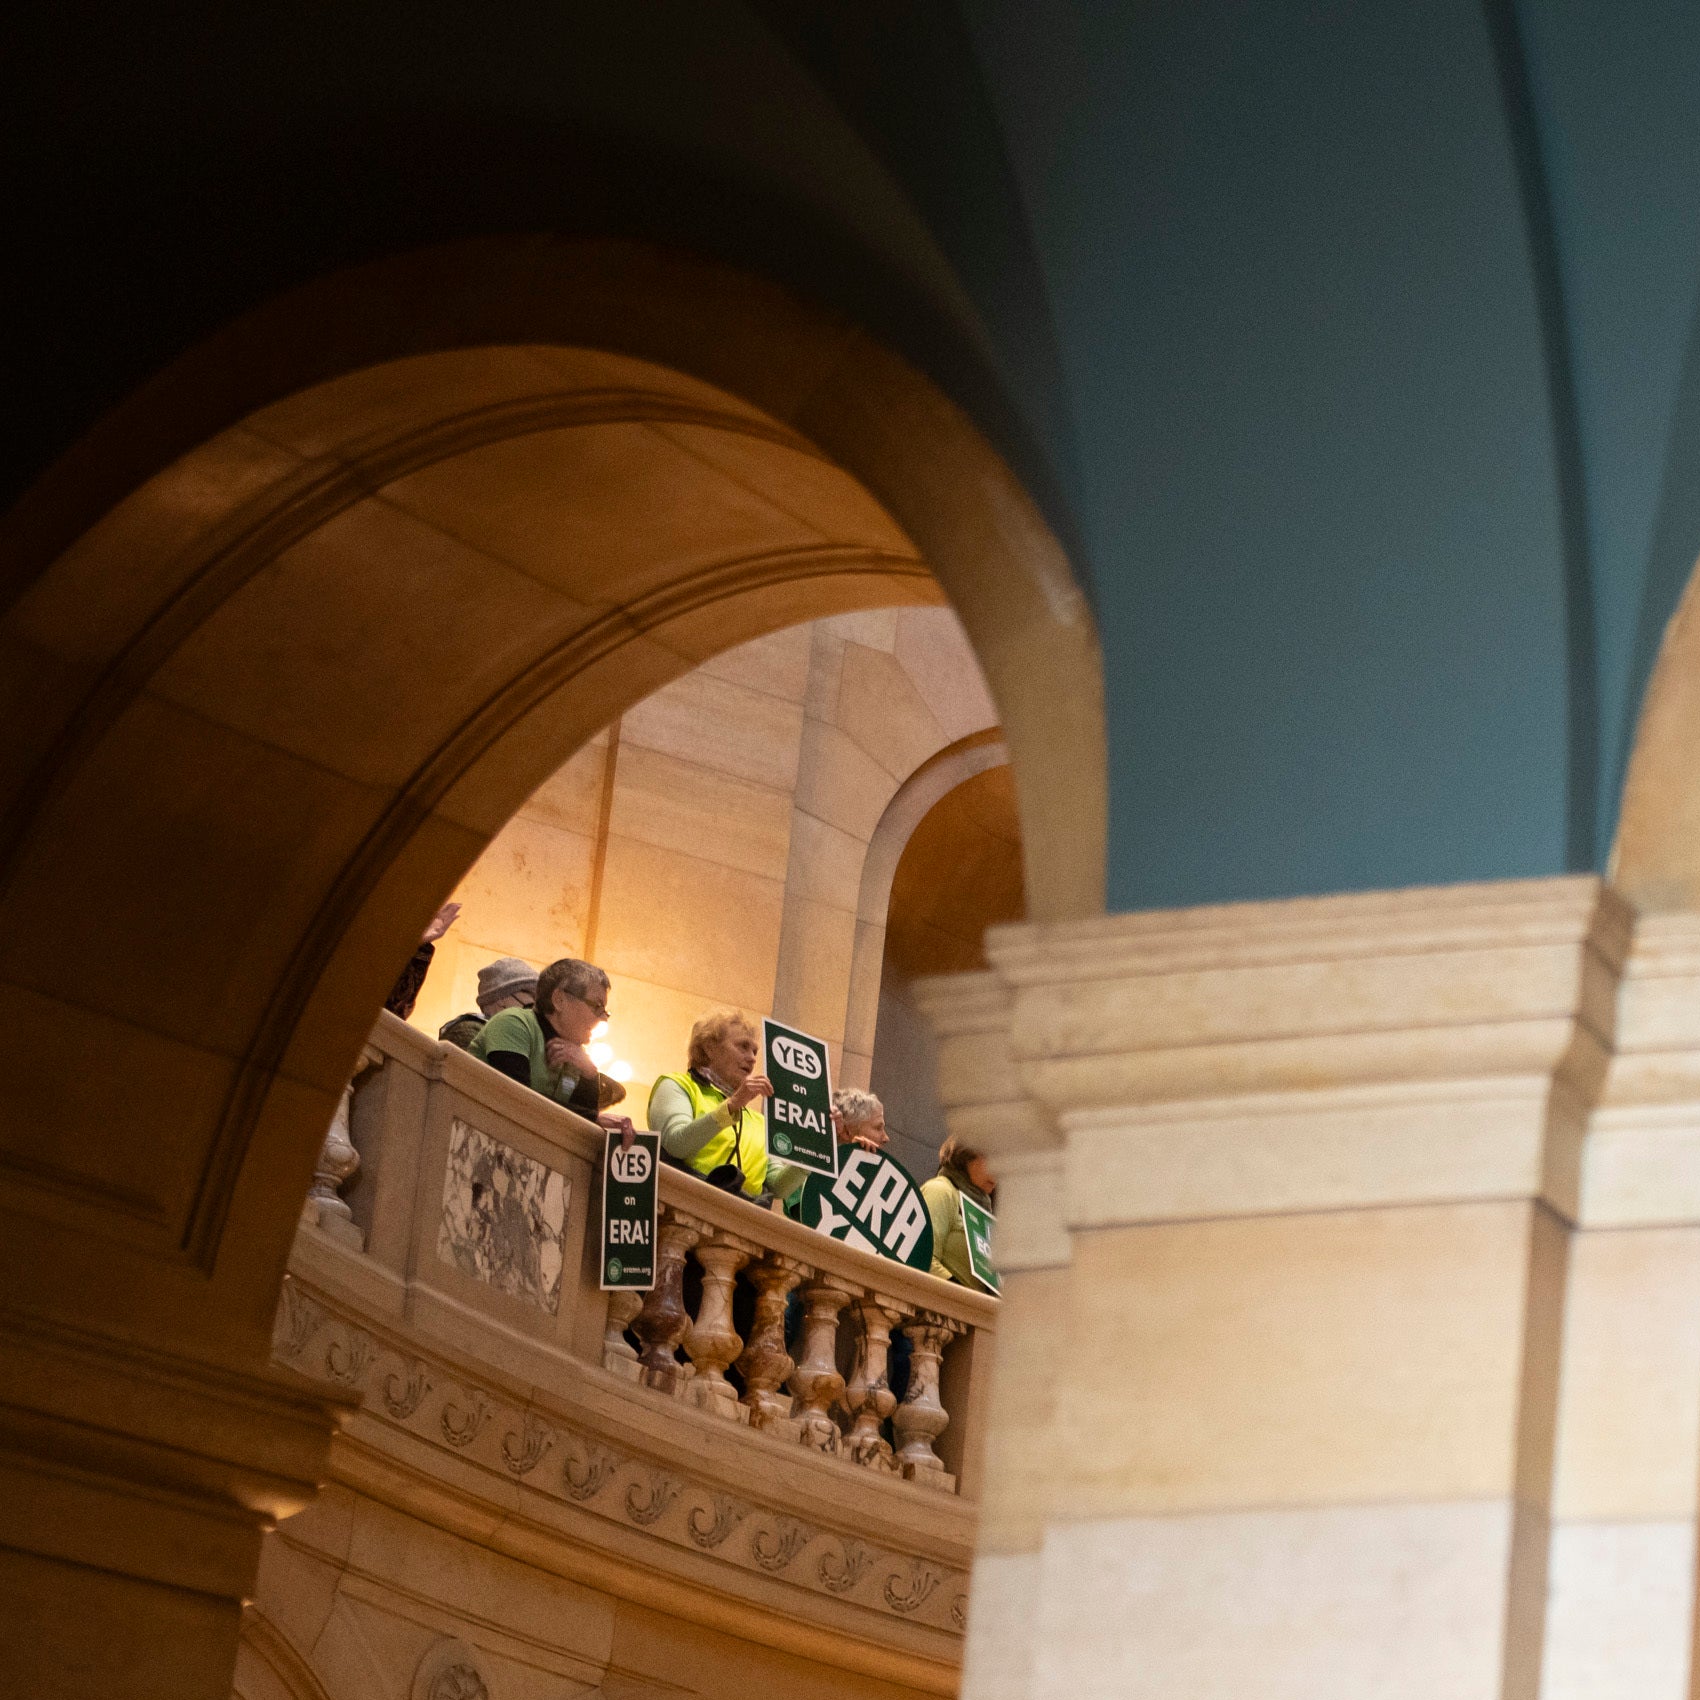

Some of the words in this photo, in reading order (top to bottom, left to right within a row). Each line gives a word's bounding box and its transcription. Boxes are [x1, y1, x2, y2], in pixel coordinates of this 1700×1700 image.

[777, 1041, 817, 1075] YES
[792, 1083, 807, 1096] on
[774, 1097, 827, 1135] ERA!
[615, 1153, 647, 1177] YES
[624, 1196, 636, 1206] on
[831, 1149, 927, 1264] ERA
[609, 1219, 650, 1245] ERA!
